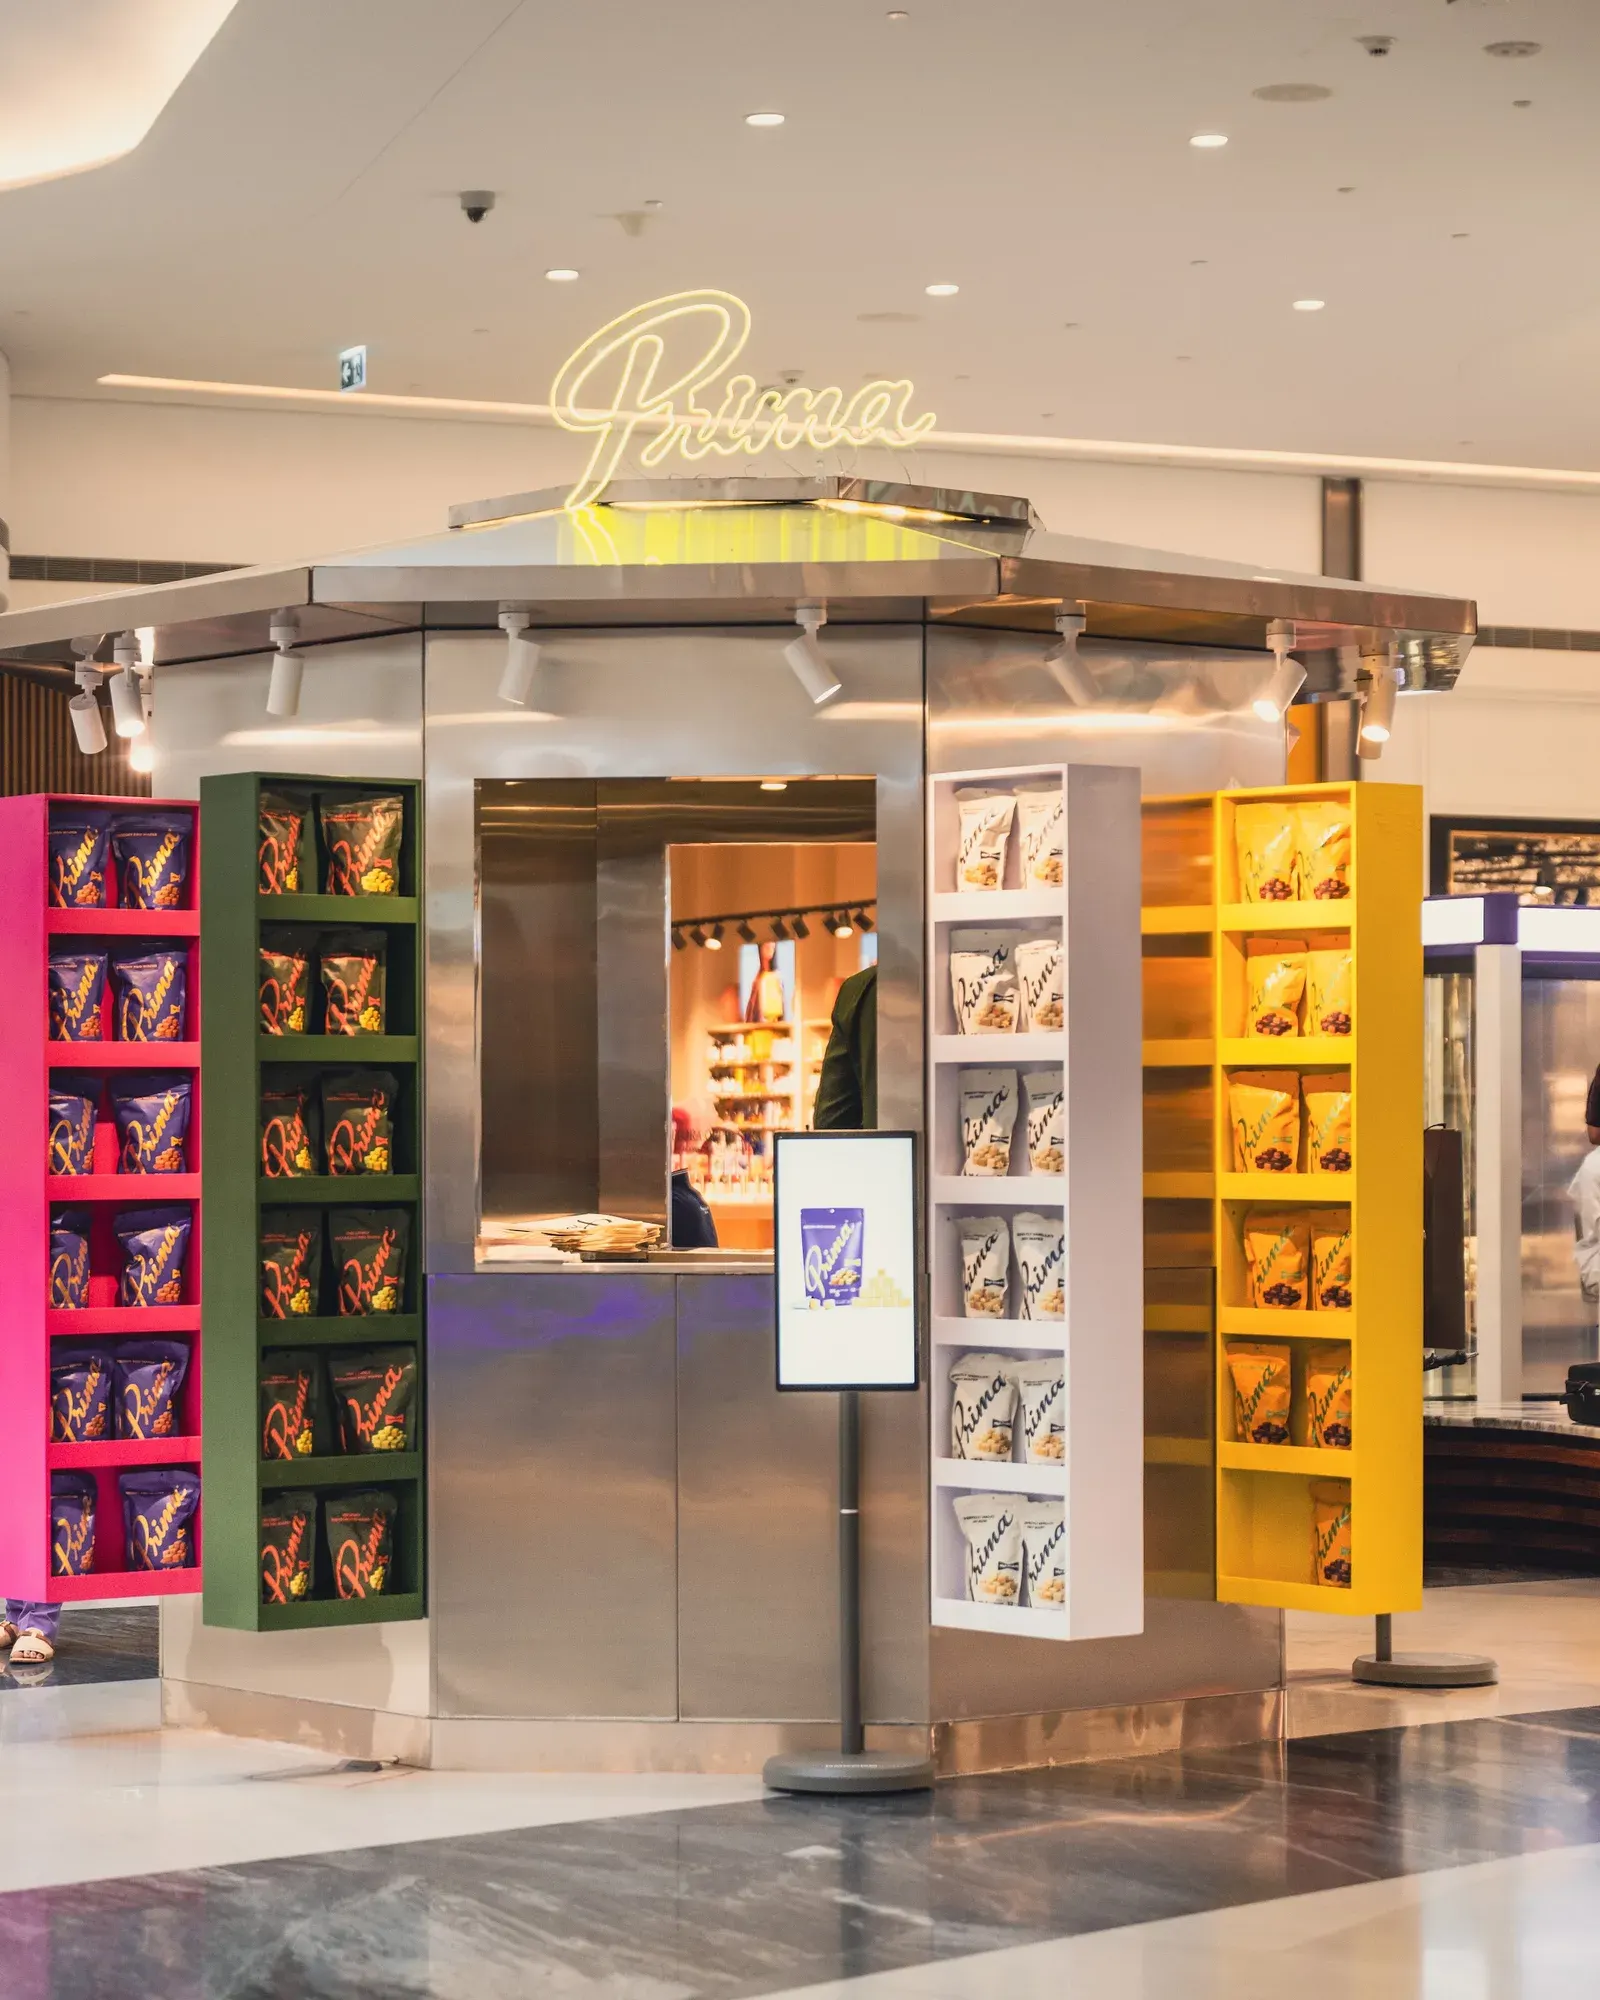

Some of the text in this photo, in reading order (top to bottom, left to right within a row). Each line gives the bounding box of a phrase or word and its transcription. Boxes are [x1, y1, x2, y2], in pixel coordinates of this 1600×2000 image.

[551, 289, 936, 509] Prima
[122, 957, 178, 1042] Prima
[123, 1090, 180, 1174] Prima
[329, 1089, 384, 1175] Prima
[338, 1227, 396, 1316] Prima
[804, 1220, 862, 1299] Prima
[964, 1229, 999, 1305] rima
[335, 1509, 385, 1598] Prima
